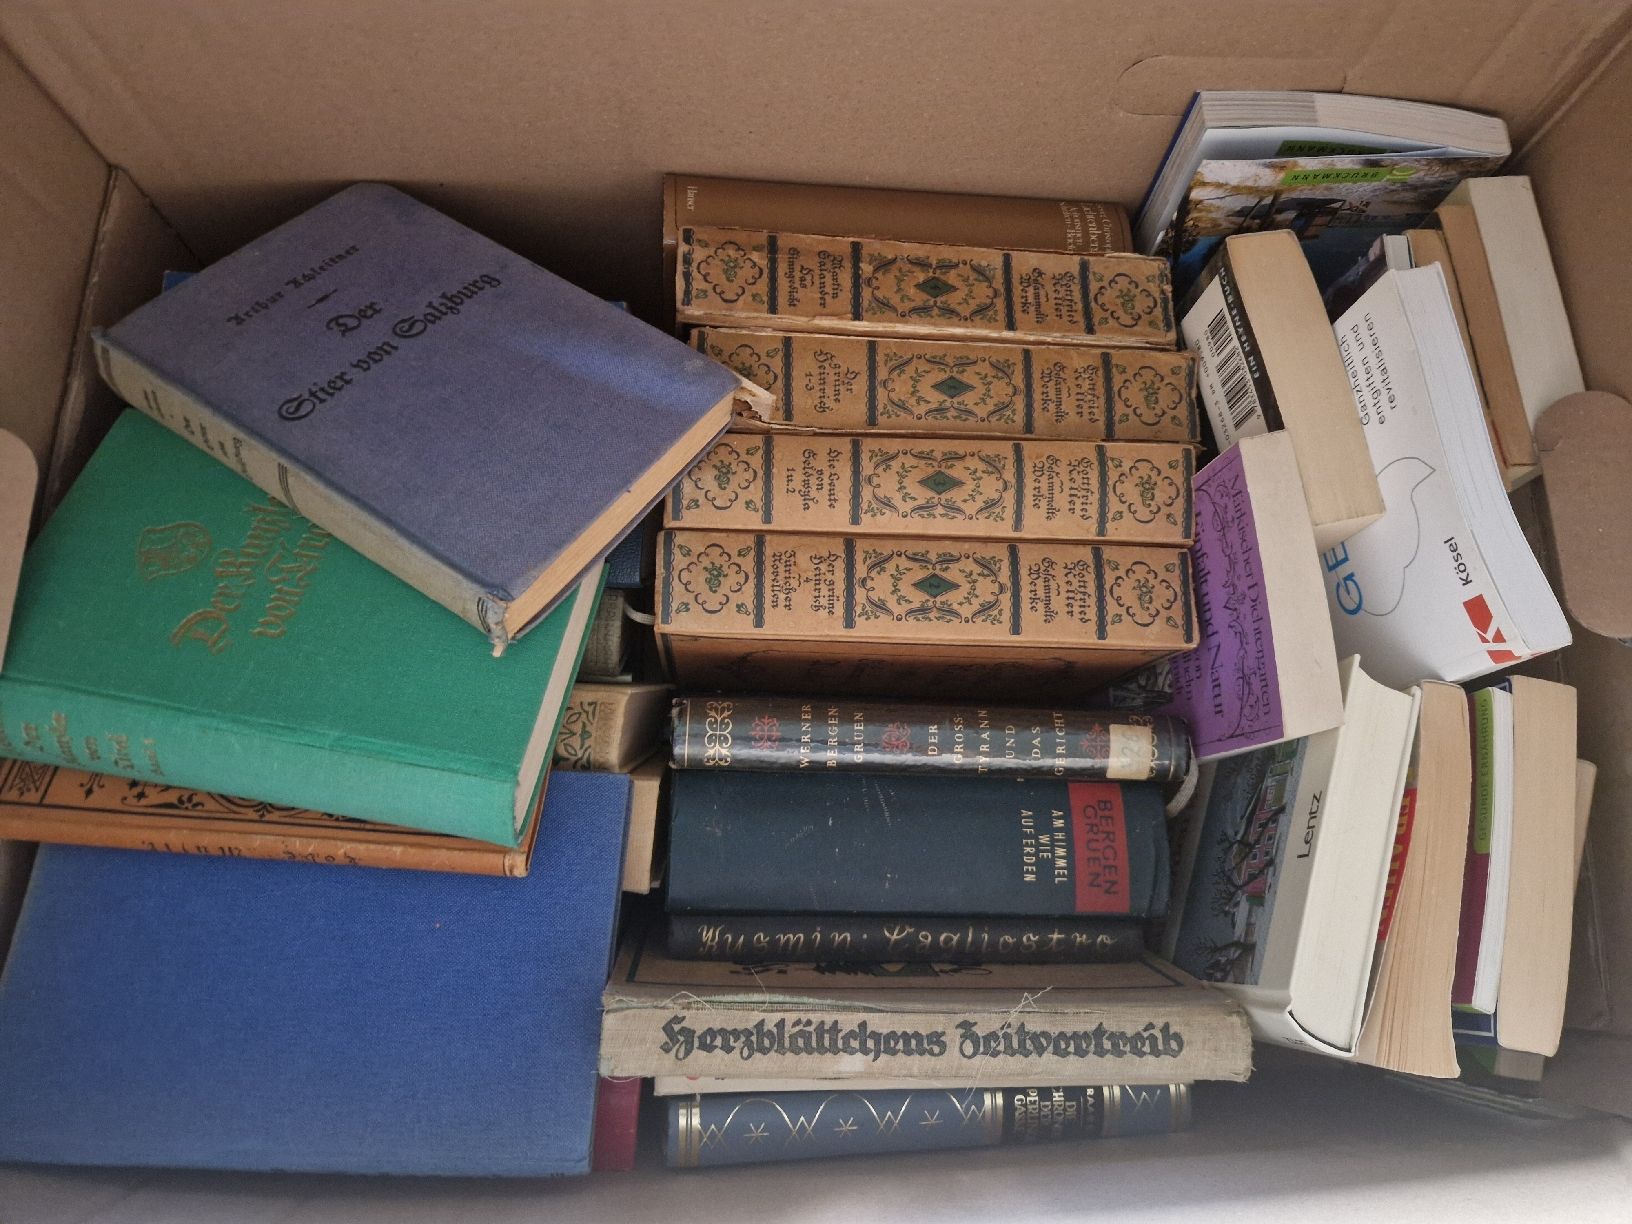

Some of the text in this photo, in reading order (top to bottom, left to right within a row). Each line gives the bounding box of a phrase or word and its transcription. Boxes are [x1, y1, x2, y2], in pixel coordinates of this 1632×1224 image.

[1292, 171, 1380, 181] BRUCKMANN
[326, 300, 384, 337] Der
[1063, 271, 1079, 325] Gottfried
[277, 273, 502, 421] Stier von Salzburg
[1249, 356, 1260, 379] EIN
[1350, 323, 1386, 425] entgiften und
[1364, 312, 1397, 410] revitalisieren
[1074, 366, 1088, 418] Keller
[1087, 364, 1100, 423] Gottfried
[1340, 334, 1371, 425] Ganzheitlich
[827, 447, 843, 470] Die
[1032, 460, 1047, 510] Werke
[1067, 459, 1081, 515] Keller
[1080, 456, 1094, 521] Gottfried
[771, 552, 784, 609] Novellen
[810, 553, 826, 612] Heinrich
[828, 550, 842, 573] Der
[1028, 562, 1043, 613] Werke
[1062, 562, 1077, 618] Keller
[1443, 536, 1473, 587] Kösel
[1076, 559, 1091, 624] Gottfried
[1228, 473, 1272, 717] Märkischer Dichtergarten
[1207, 644, 1225, 719] Natur
[800, 704, 812, 769] WERNER
[853, 712, 864, 763] GRUEN
[928, 724, 939, 756] DER
[977, 709, 990, 774] TYRANN
[1005, 724, 1016, 759] UND
[1031, 726, 1042, 758] DAS
[1052, 711, 1066, 776] GERICHT
[1020, 809, 1036, 882] AUF ERDEN
[1038, 834, 1052, 859] WIE
[1051, 809, 1068, 884] AM HIMMEL
[1083, 804, 1102, 889] GRUEN
[1098, 799, 1119, 896] BERGEN
[1296, 790, 1323, 859] Lentz
[659, 1014, 1185, 1062] Herzblättchens Zeitvertreib
